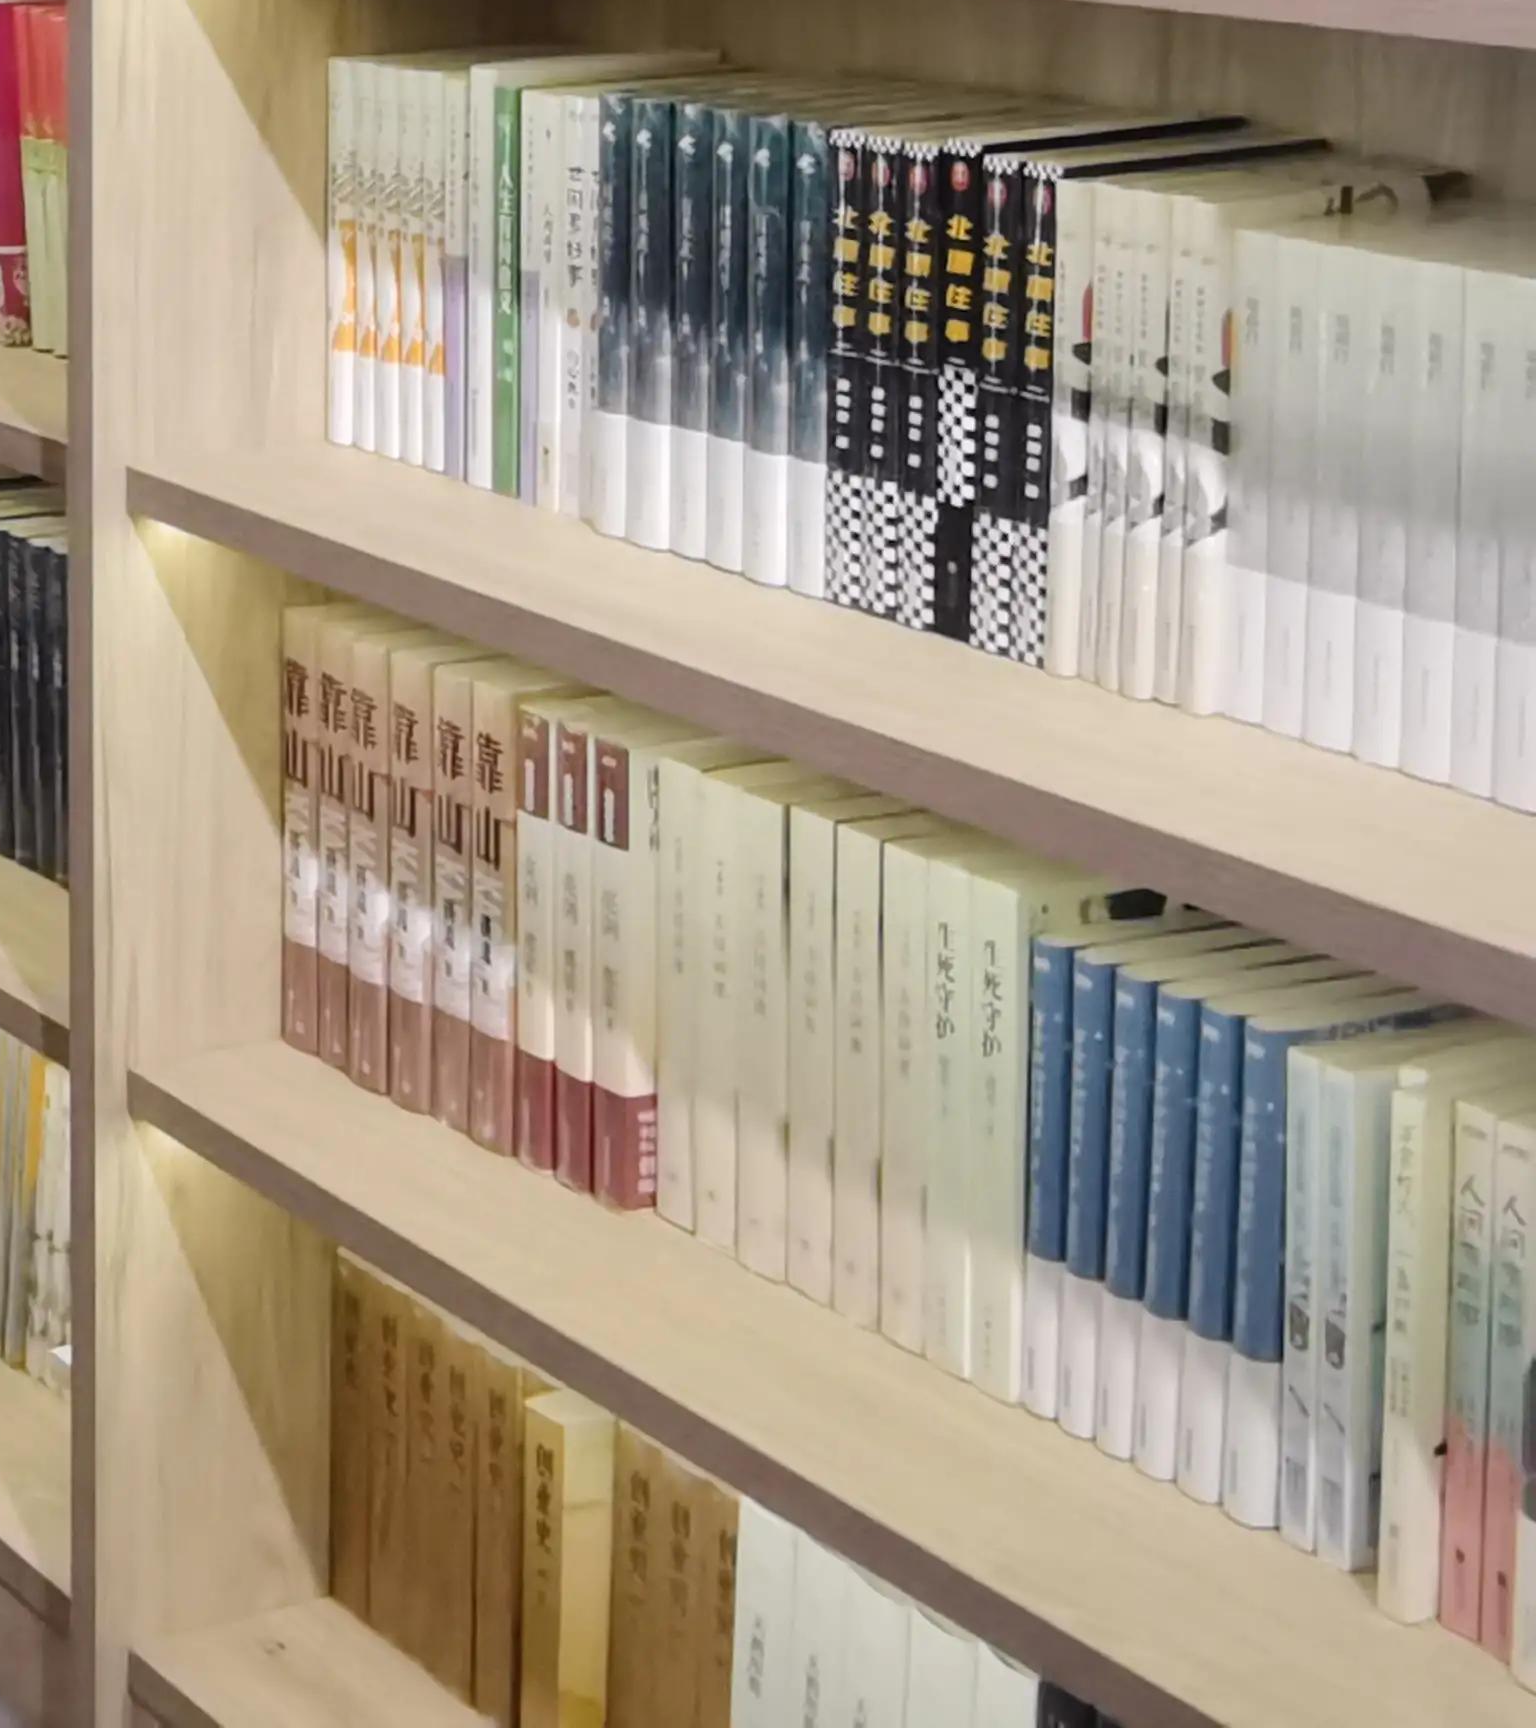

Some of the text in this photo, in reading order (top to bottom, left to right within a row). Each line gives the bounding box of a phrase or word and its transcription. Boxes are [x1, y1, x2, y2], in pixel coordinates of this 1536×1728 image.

[285, 656, 310, 789] 靠山
[320, 671, 348, 804] 靠山
[350, 686, 378, 823] 靠山
[391, 700, 419, 838] 靠山
[436, 716, 466, 856] 靠山
[476, 731, 505, 871] 靠山
